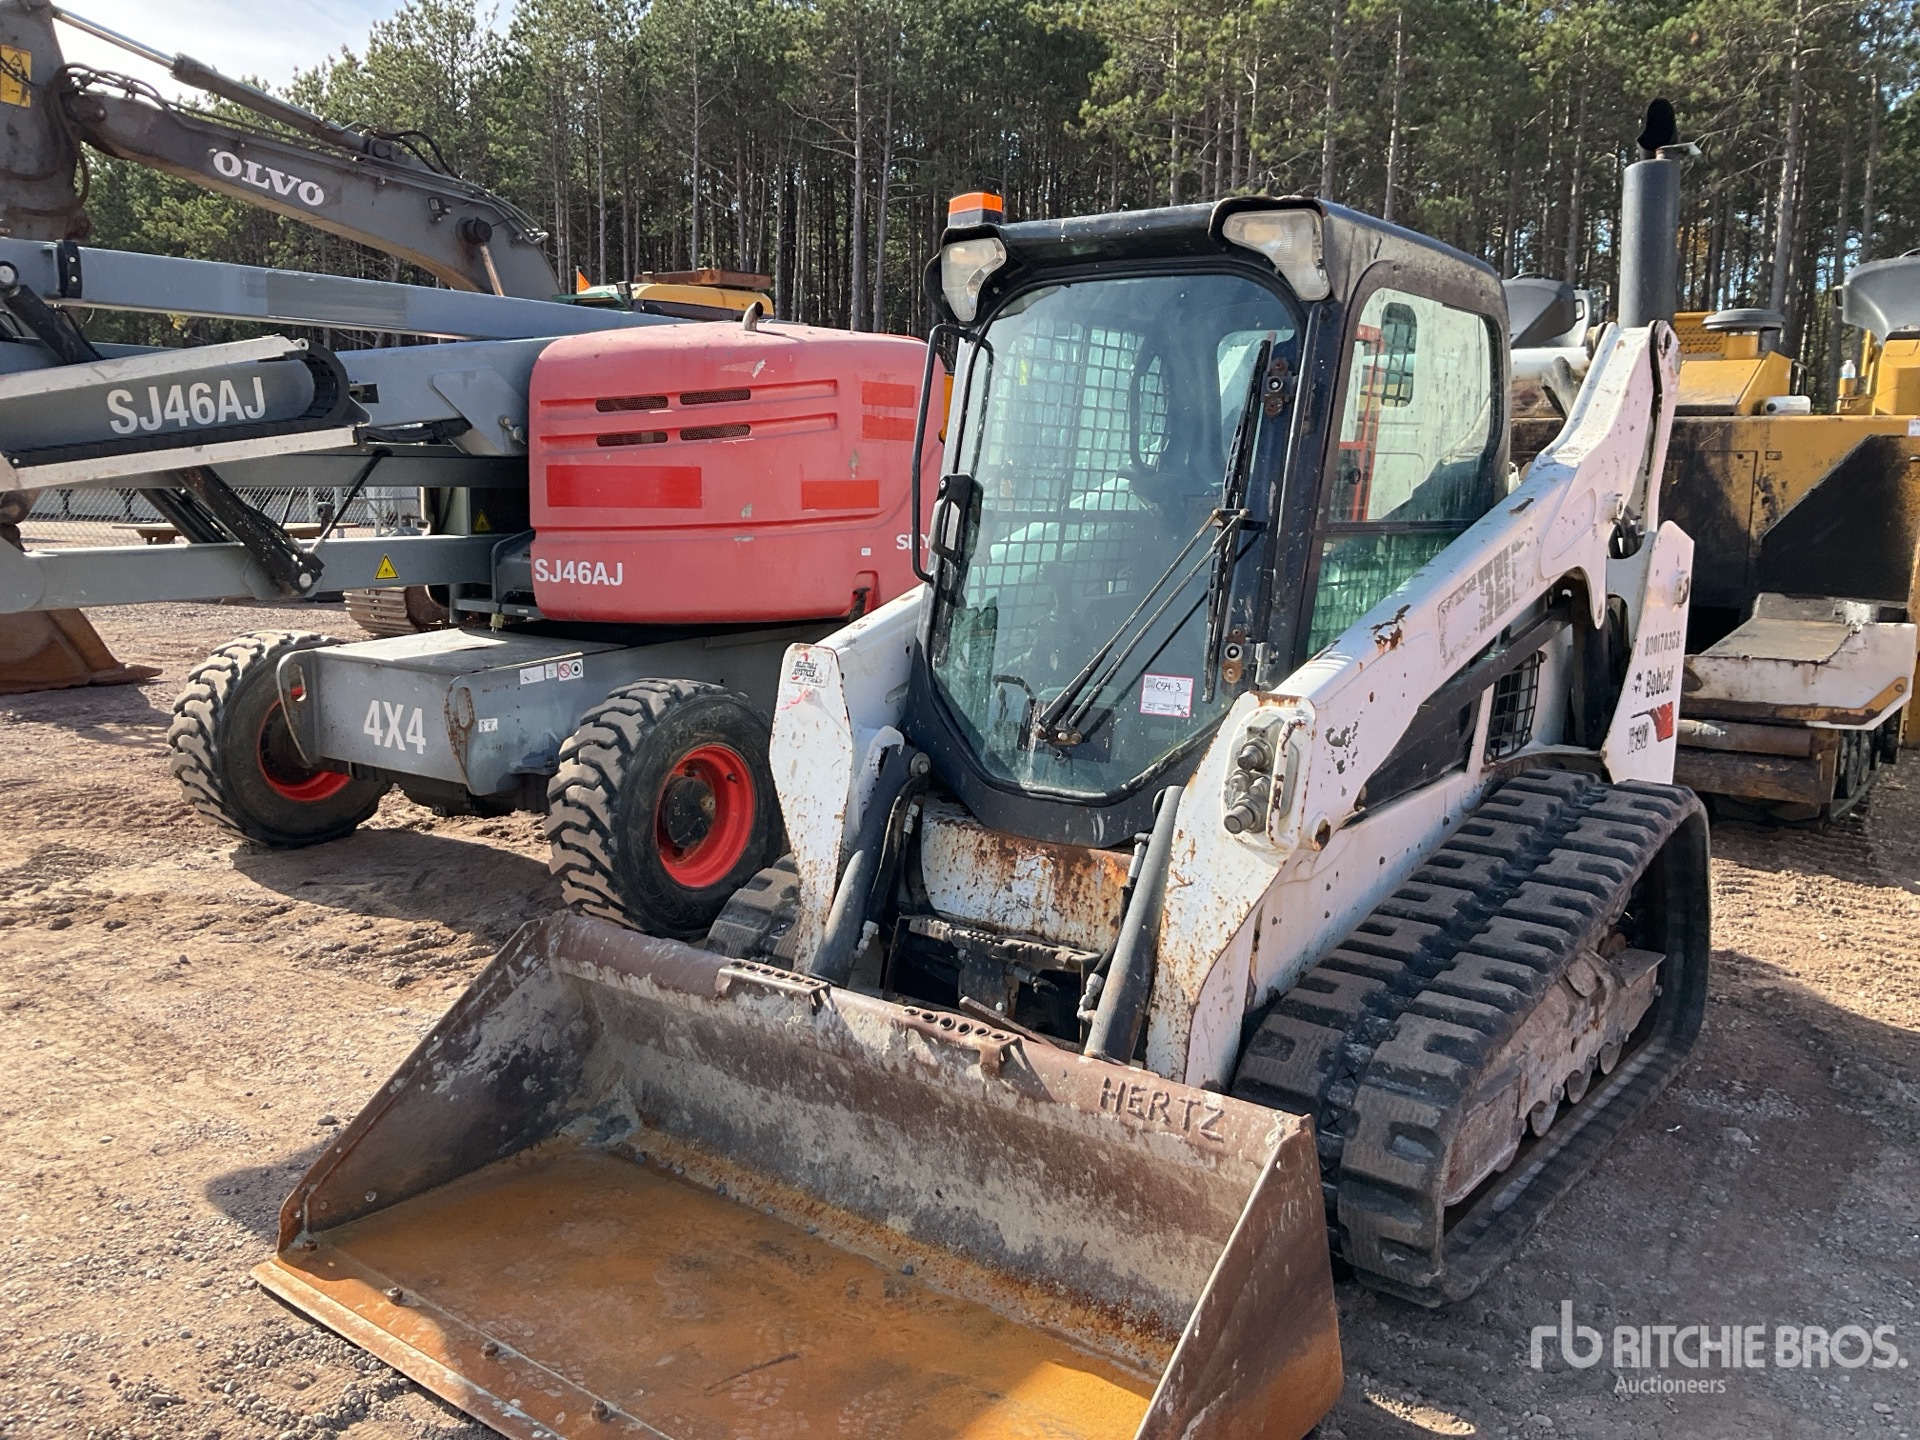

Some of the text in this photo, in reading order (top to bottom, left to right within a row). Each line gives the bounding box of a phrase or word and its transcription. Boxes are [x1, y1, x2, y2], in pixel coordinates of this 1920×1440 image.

[208, 147, 325, 206] OLVO
[106, 376, 266, 434] SJ46AJ
[534, 558, 624, 586] SJ46AJ
[363, 699, 427, 755] 4X4
[1099, 1076, 1226, 1143] HERTZ
